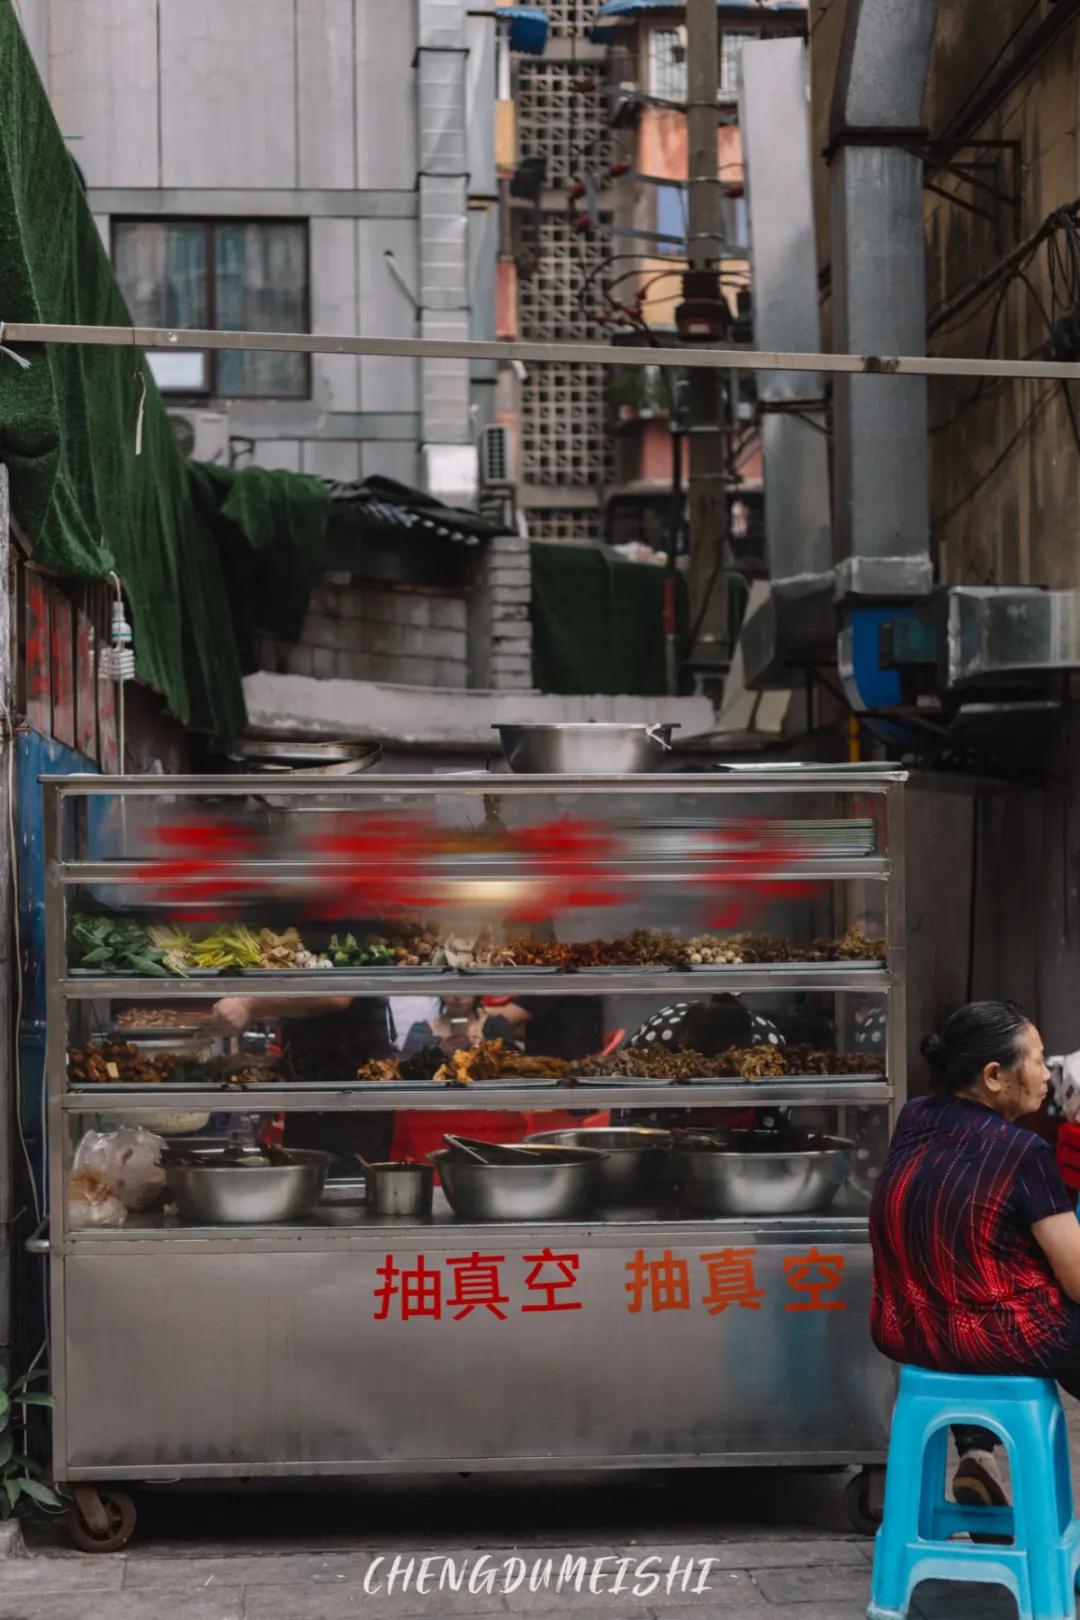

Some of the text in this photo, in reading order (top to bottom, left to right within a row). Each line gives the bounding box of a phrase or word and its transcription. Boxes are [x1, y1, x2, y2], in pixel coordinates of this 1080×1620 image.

[373, 1247, 847, 1321] 抽真空 抽真空
